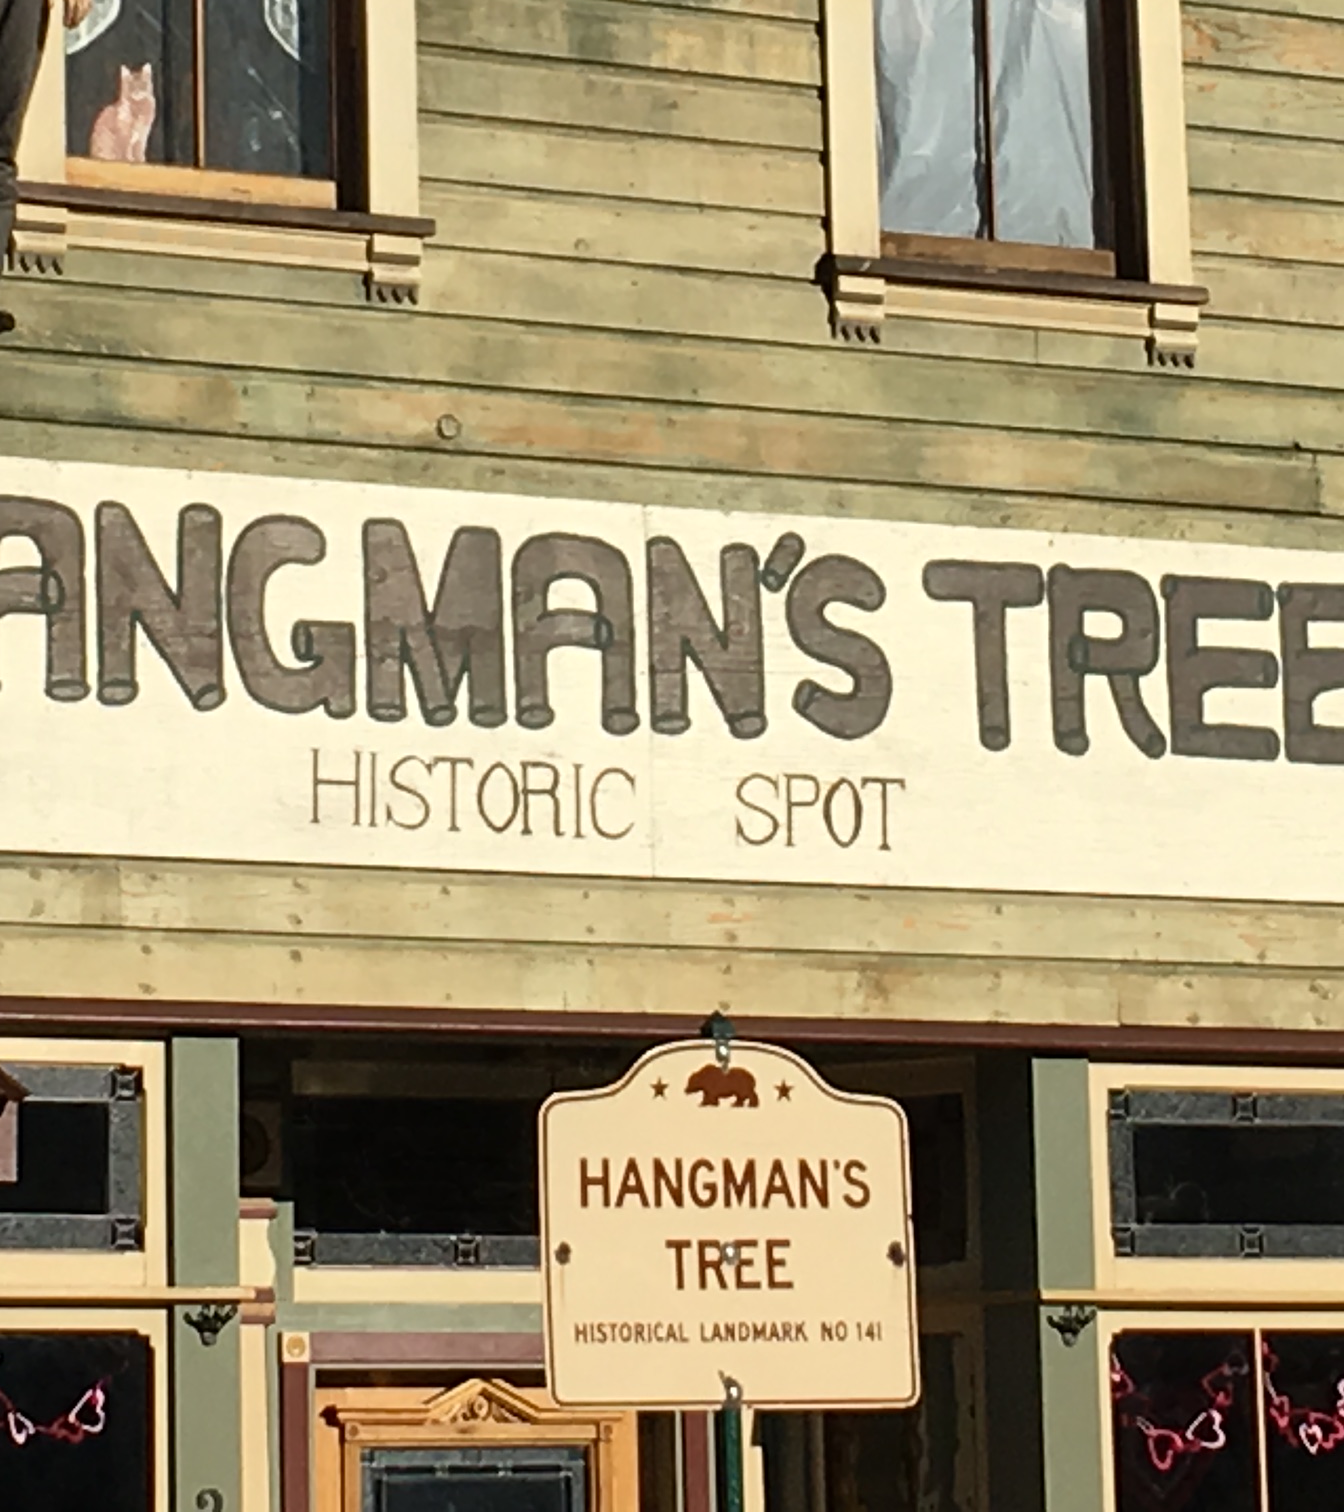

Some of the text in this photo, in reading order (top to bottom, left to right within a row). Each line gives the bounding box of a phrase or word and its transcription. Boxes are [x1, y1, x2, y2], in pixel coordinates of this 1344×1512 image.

[309, 748, 907, 852] HISTORIC SPOT
[579, 1156, 871, 1210] HANGMAN'S
[664, 1238, 795, 1291] TREE
[574, 1320, 882, 1345] HISTORICAL LANDMARK NO 141
